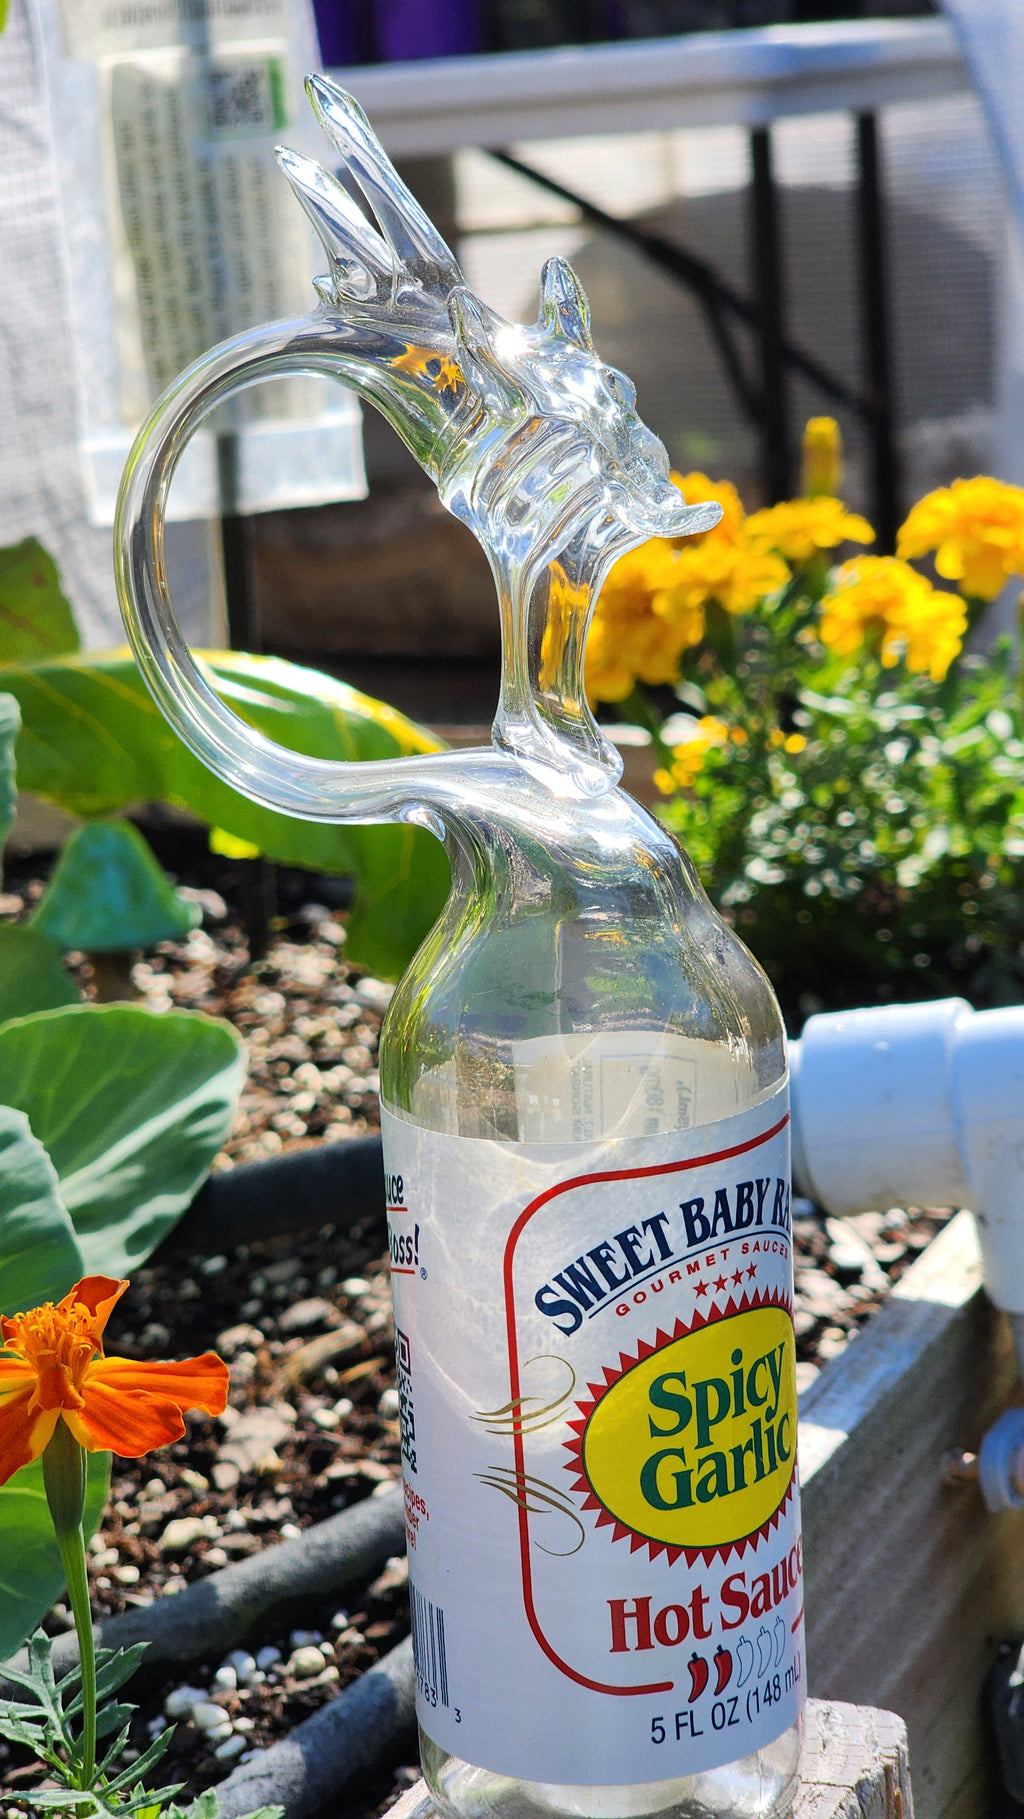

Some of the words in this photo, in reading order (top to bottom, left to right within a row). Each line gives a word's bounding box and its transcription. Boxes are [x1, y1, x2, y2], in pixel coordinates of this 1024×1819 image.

[386, 1174, 404, 1204] uce
[534, 1211, 674, 1337] SWEET
[679, 1177, 771, 1248] BABY
[771, 1177, 790, 1236] RA
[615, 1248, 730, 1317] GOURMET
[648, 1341, 785, 1450] Spicy
[640, 1412, 791, 1511] Garlic
[606, 1584, 713, 1653] Hot
[719, 1534, 802, 1631] Sauce
[454, 1707, 462, 1723] 3
[651, 1716, 666, 1744] 5
[674, 1710, 703, 1740] FL
[711, 1696, 740, 1730] OZ
[746, 1674, 781, 1723] (148
